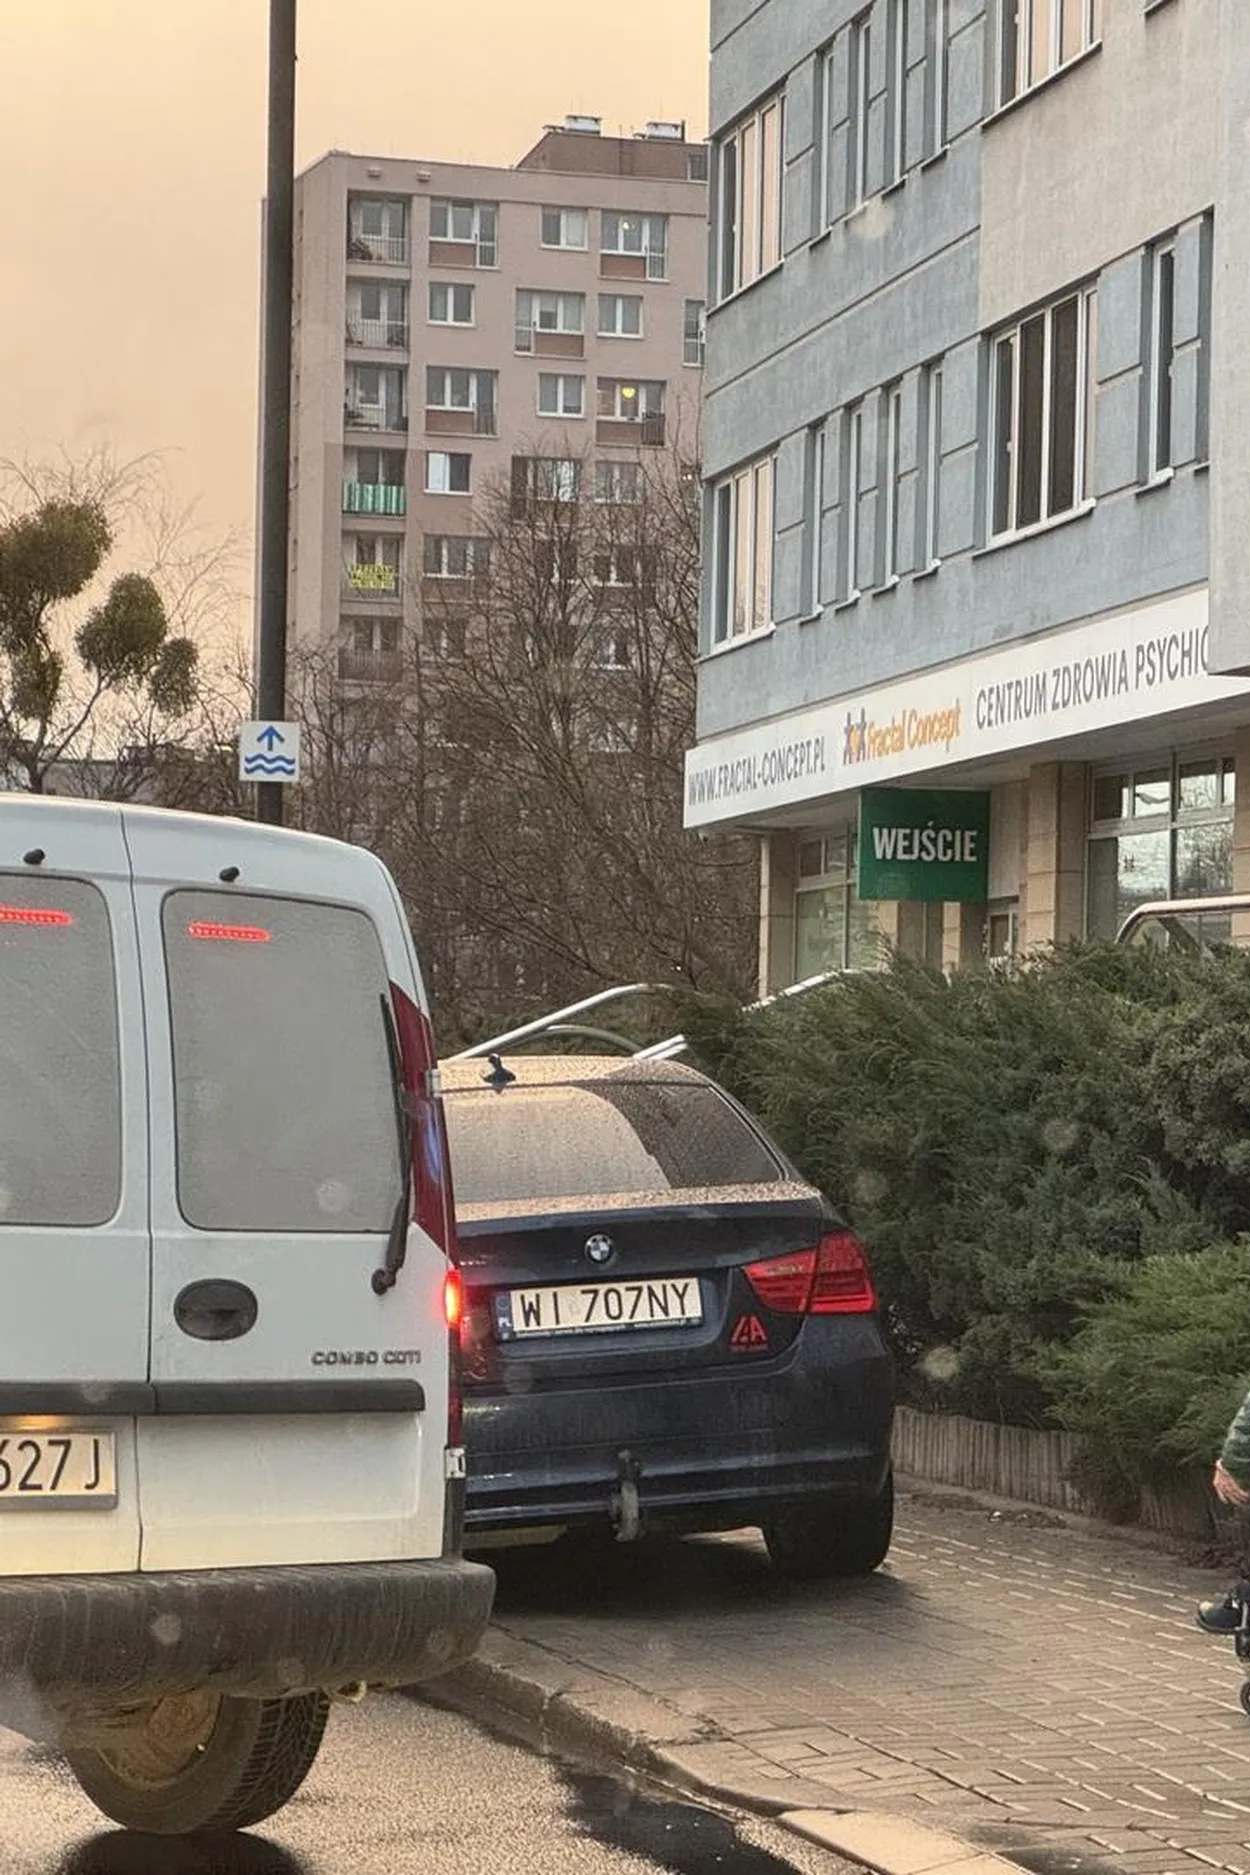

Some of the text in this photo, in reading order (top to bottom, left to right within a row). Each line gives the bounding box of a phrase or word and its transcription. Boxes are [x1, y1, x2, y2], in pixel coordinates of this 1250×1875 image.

[976, 671, 1047, 730] CENTRUM
[1051, 650, 1129, 711] ZDROWIA
[867, 697, 962, 762] Fractal Concept
[688, 736, 826, 807] WWW.FRACTAL-CONCEPT.PL
[873, 820, 978, 863] WEJŚCIE
[520, 1291, 560, 1328] WI
[580, 1282, 690, 1323] 707NY
[311, 1351, 379, 1366] COMBO
